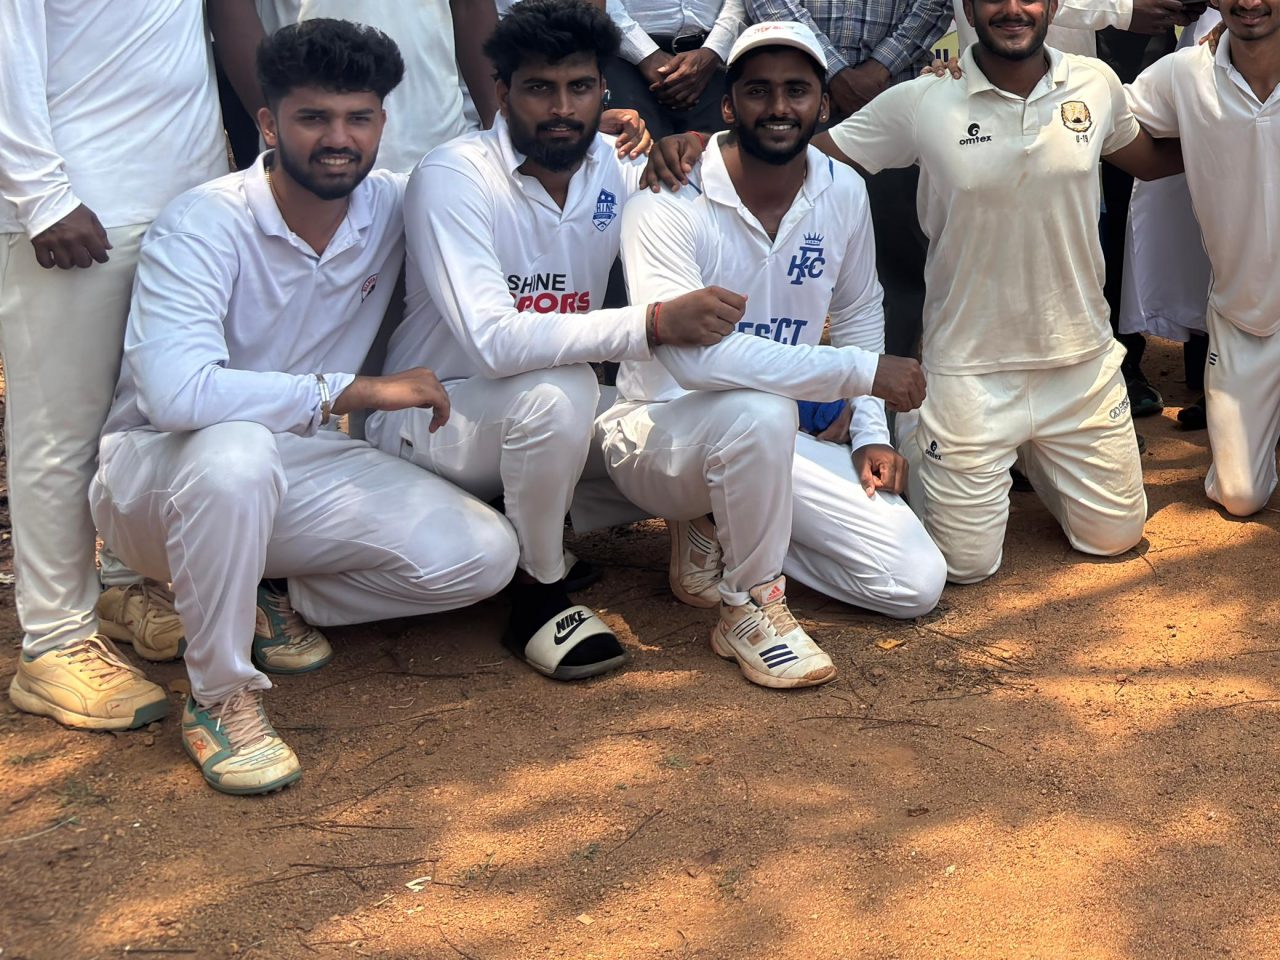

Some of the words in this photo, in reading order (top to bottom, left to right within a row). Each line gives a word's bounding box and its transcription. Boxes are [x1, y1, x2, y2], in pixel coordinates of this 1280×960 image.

[959, 135, 992, 146] omtex
[507, 273, 567, 294] SHINE
[555, 610, 584, 635] NIKE
